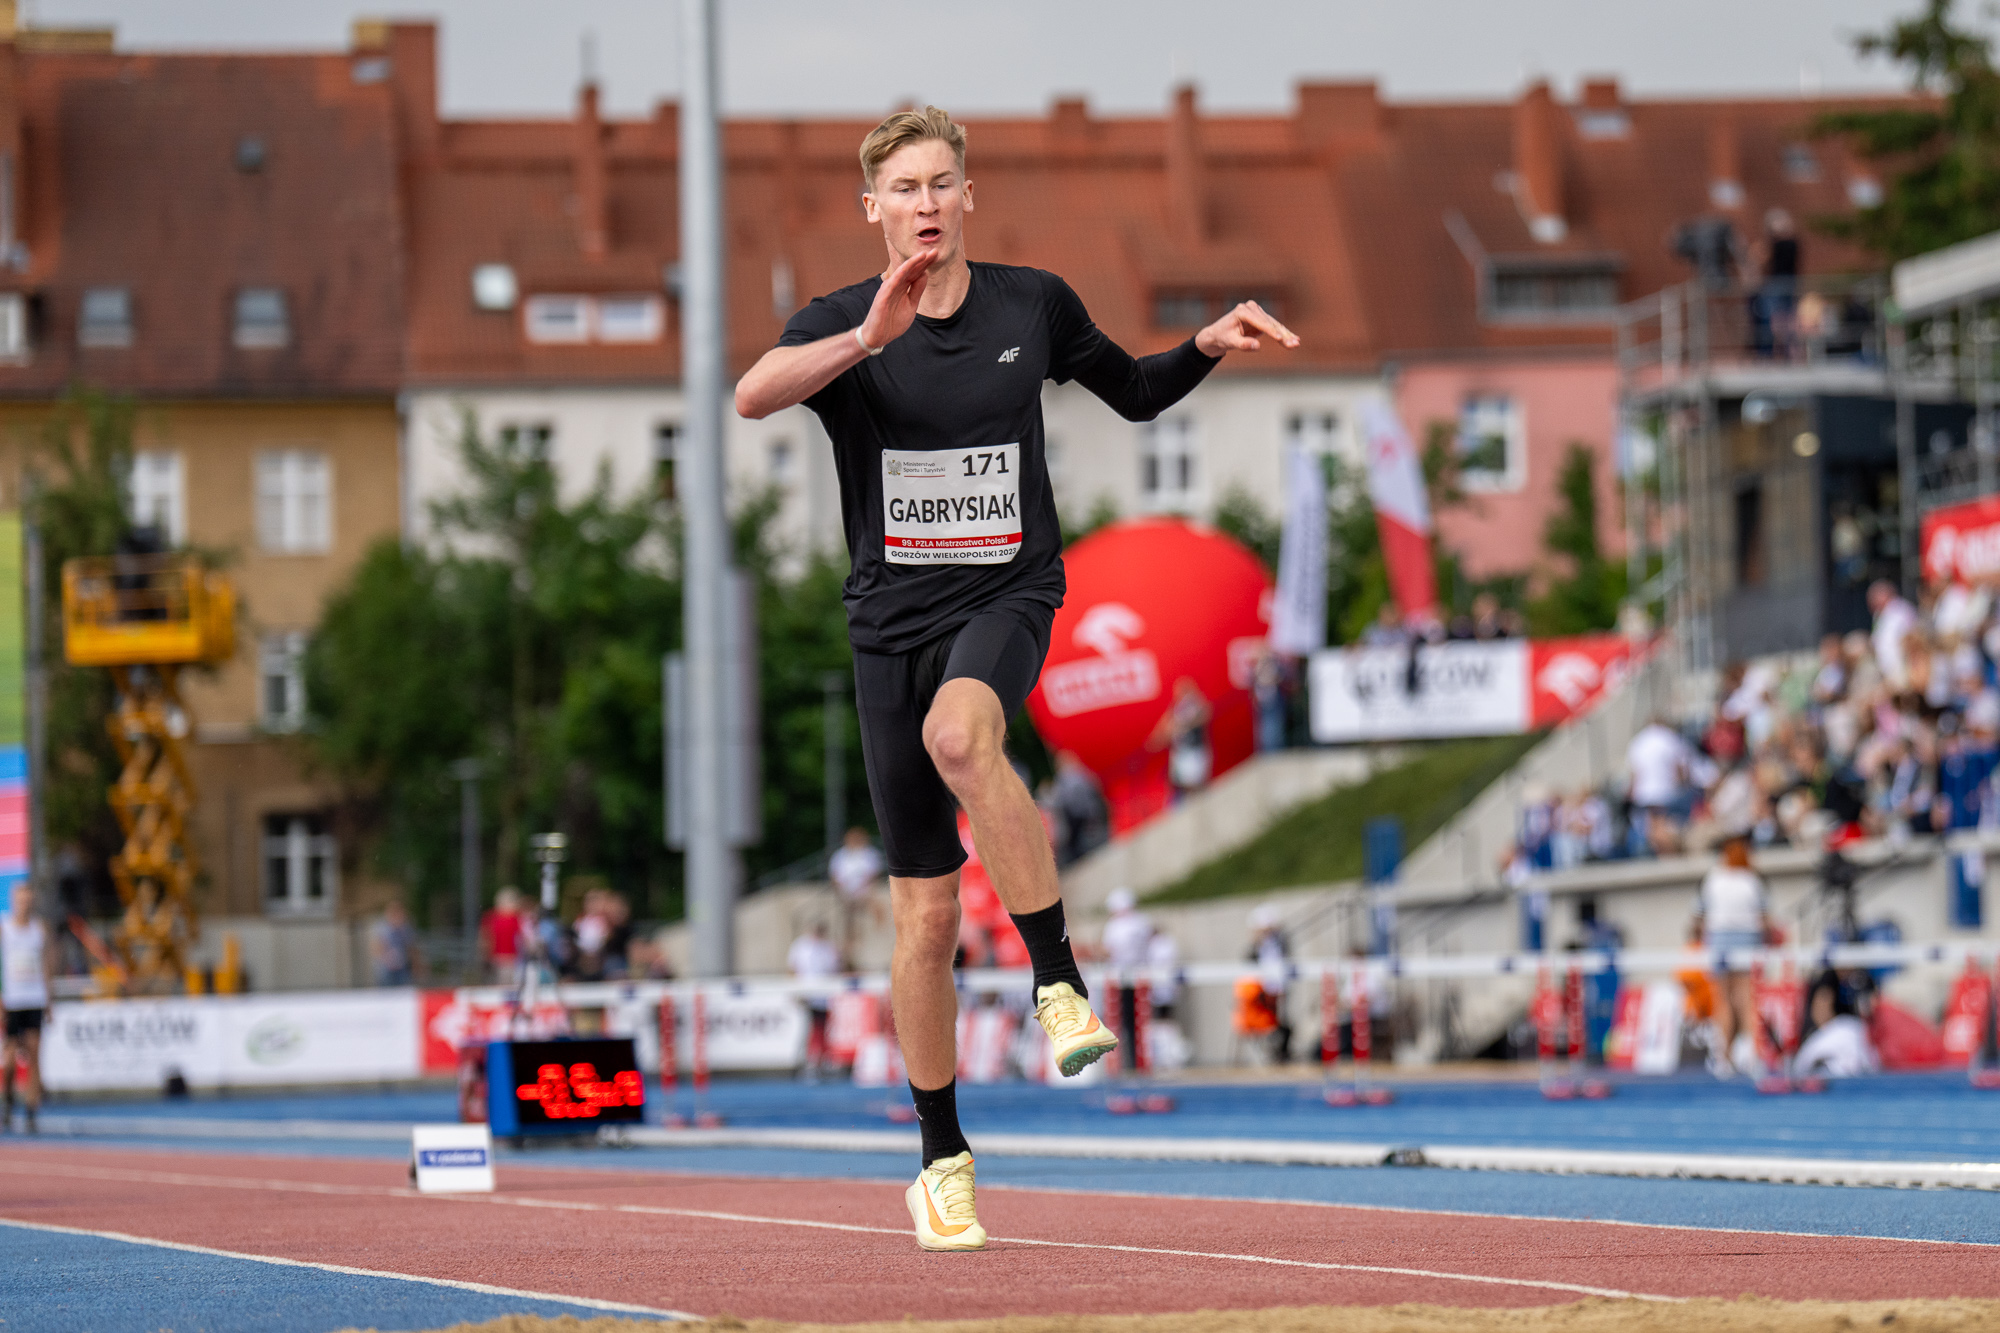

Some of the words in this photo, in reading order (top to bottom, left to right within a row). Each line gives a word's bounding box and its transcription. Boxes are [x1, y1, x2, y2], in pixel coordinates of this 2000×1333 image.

[997, 346, 1020, 363] 4F
[962, 452, 1009, 476] 171
[889, 493, 1017, 524] GABRYSIAK
[901, 539, 914, 547] 99.
[915, 540, 934, 548] PZLA
[935, 539, 984, 547] Mistrzostwa
[985, 536, 1008, 546] Polski
[891, 550, 930, 559] GORZÓW
[932, 550, 997, 559] WIELKOPOLSKI
[998, 547, 1017, 557] 2023
